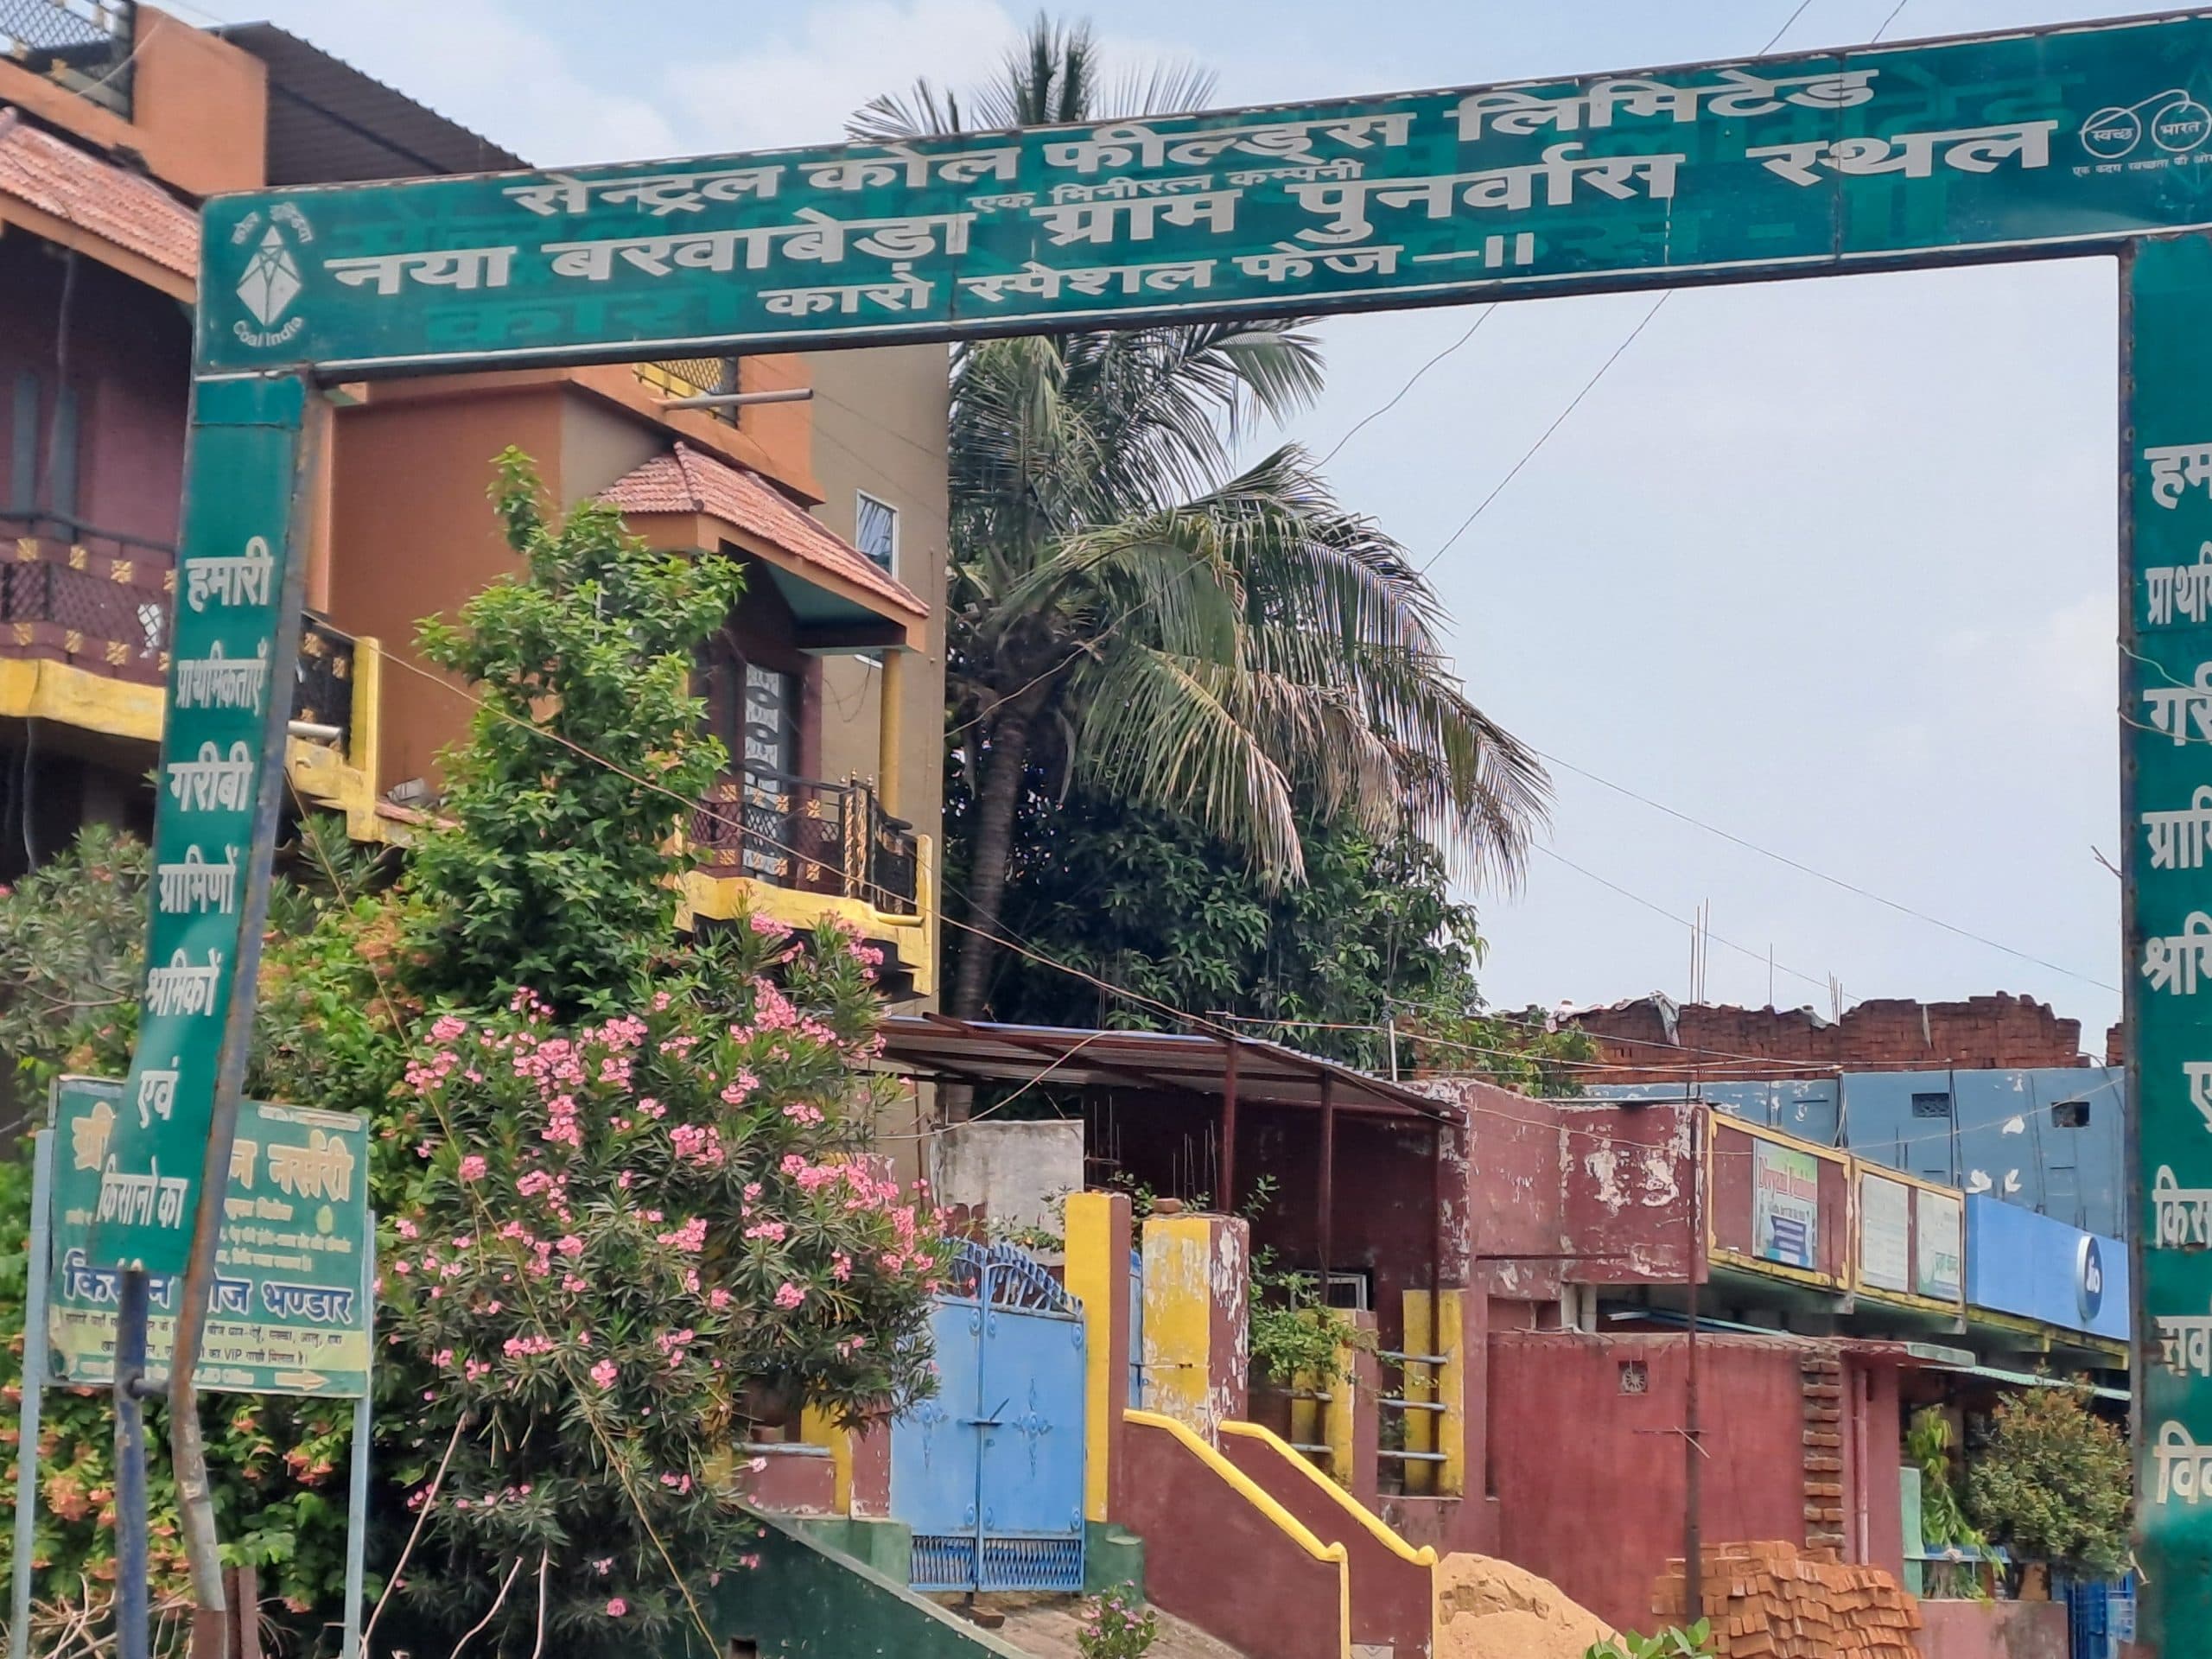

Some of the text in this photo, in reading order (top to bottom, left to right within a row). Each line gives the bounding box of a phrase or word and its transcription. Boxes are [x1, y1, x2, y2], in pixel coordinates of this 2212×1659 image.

[502, 69, 1879, 216] सेन्ट्रल कोल फील्ड्स लिमिटेड
[2160, 121, 2202, 136] भारत
[323, 245, 518, 296] नया
[1029, 188, 1243, 246] ग्राम
[1284, 142, 1686, 244] पुनर्वास
[1745, 120, 2058, 187] स्थल
[967, 157, 1364, 213] एक मिनीरत्न कम्पनी
[757, 270, 935, 316] कारो
[957, 259, 1217, 302] स्पेशल
[232, 316, 303, 347] Coal India
[2144, 442, 2212, 509] हम
[185, 536, 275, 612] हमारी
[167, 741, 255, 812] गरीबी
[157, 843, 239, 914] ग्रामिणों
[143, 947, 222, 1017] श्रमिकों
[137, 1055, 180, 1129] एवं
[158, 1176, 188, 1230] का
[262, 1279, 353, 1325] भण्डार
[224, 1348, 243, 1361] VIP
